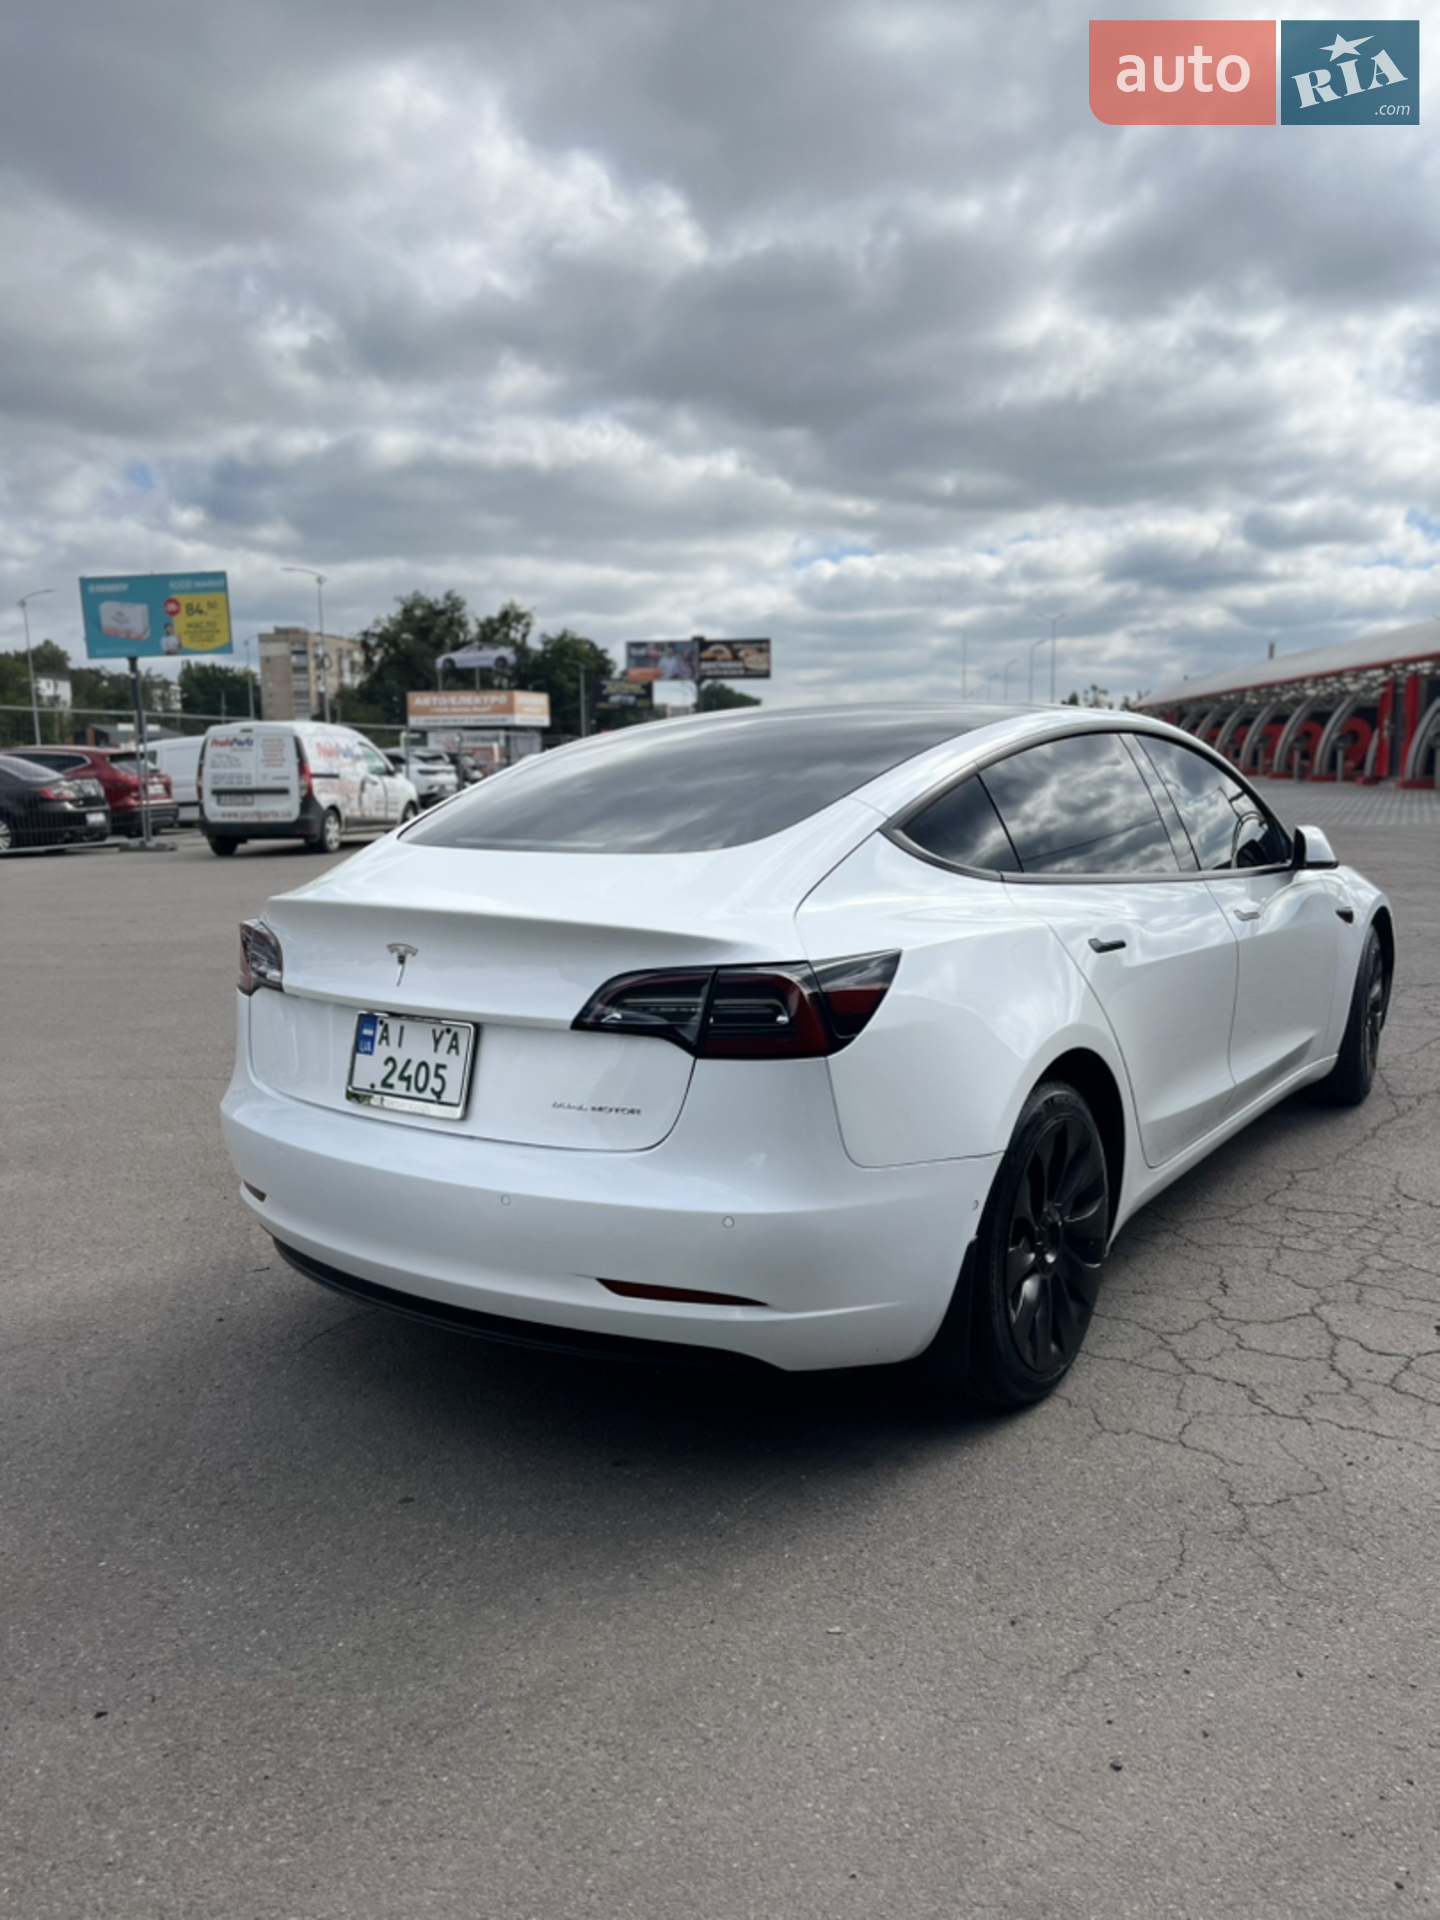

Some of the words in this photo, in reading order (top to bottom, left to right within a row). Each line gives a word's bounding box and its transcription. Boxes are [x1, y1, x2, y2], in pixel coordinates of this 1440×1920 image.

[378, 1023, 404, 1048] AI
[431, 1028, 460, 1056] YA
[380, 1056, 448, 1096] 2405
